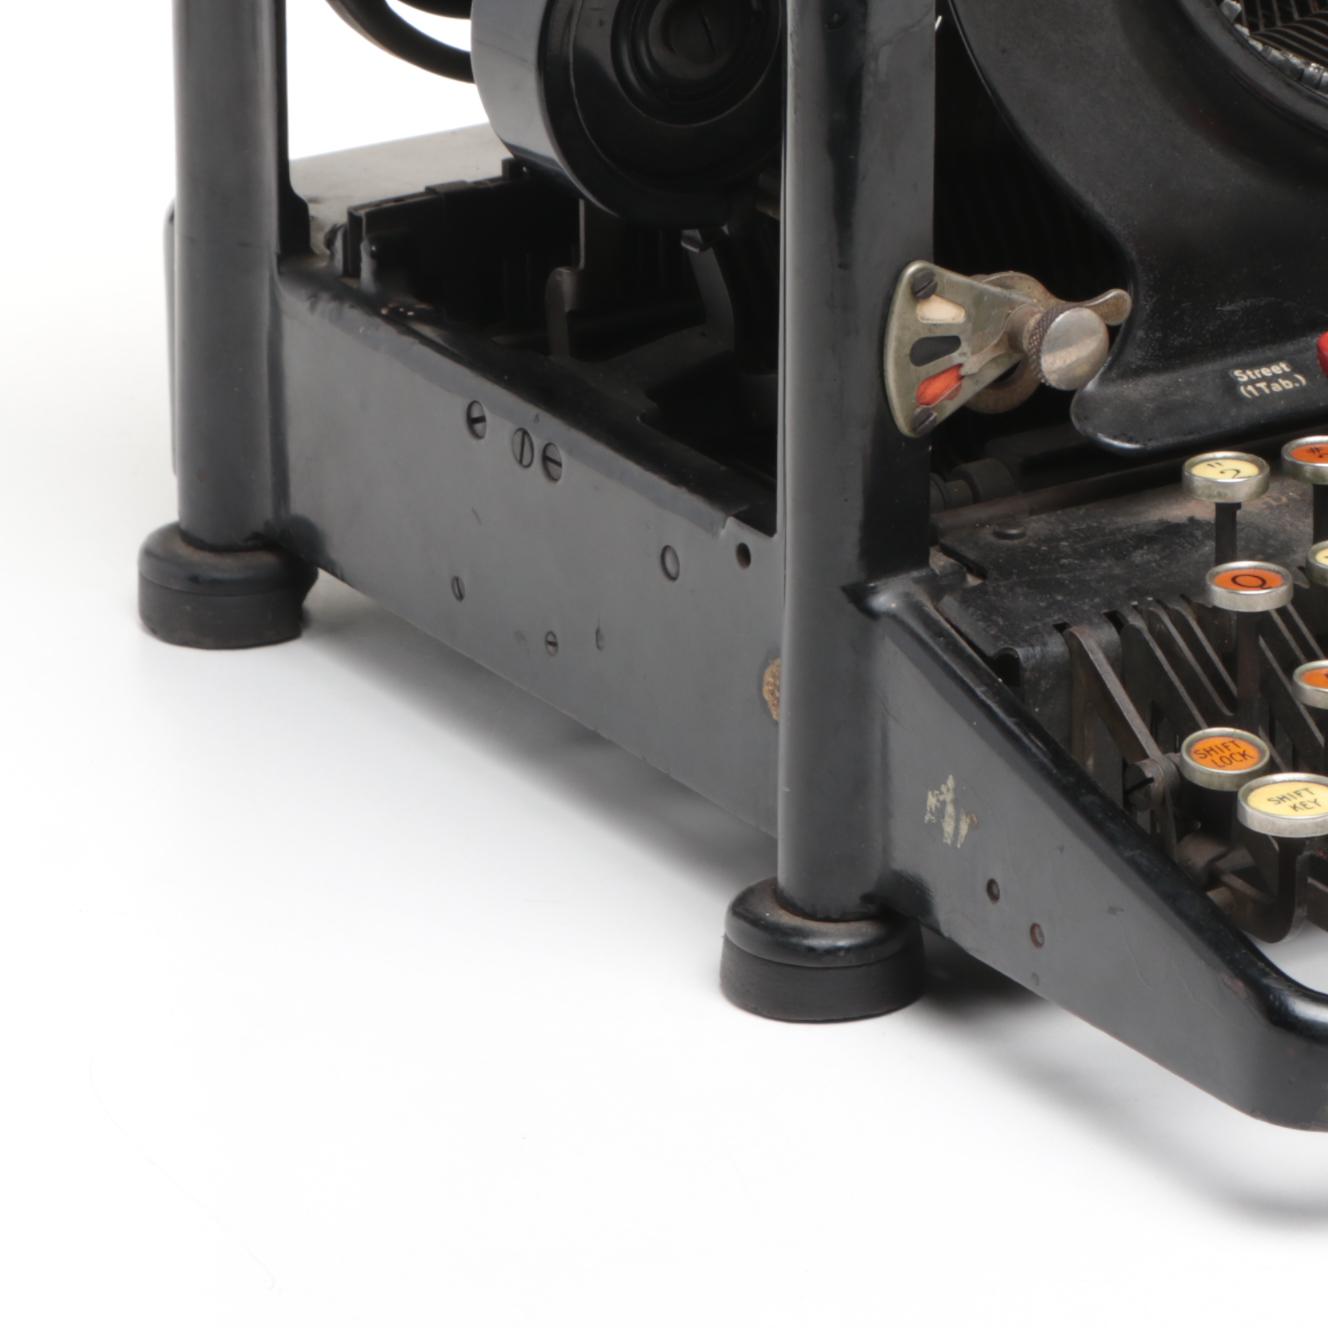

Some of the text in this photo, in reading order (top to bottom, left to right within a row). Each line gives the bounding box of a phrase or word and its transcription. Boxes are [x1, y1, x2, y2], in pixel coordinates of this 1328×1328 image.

[1233, 361, 1291, 381] Street
[1232, 574, 1272, 589] Q
[1192, 739, 1242, 760] SHIFT
[1211, 750, 1256, 769] LOCK
[1266, 787, 1317, 805] SHIFT
[1288, 798, 1323, 812] KEY
